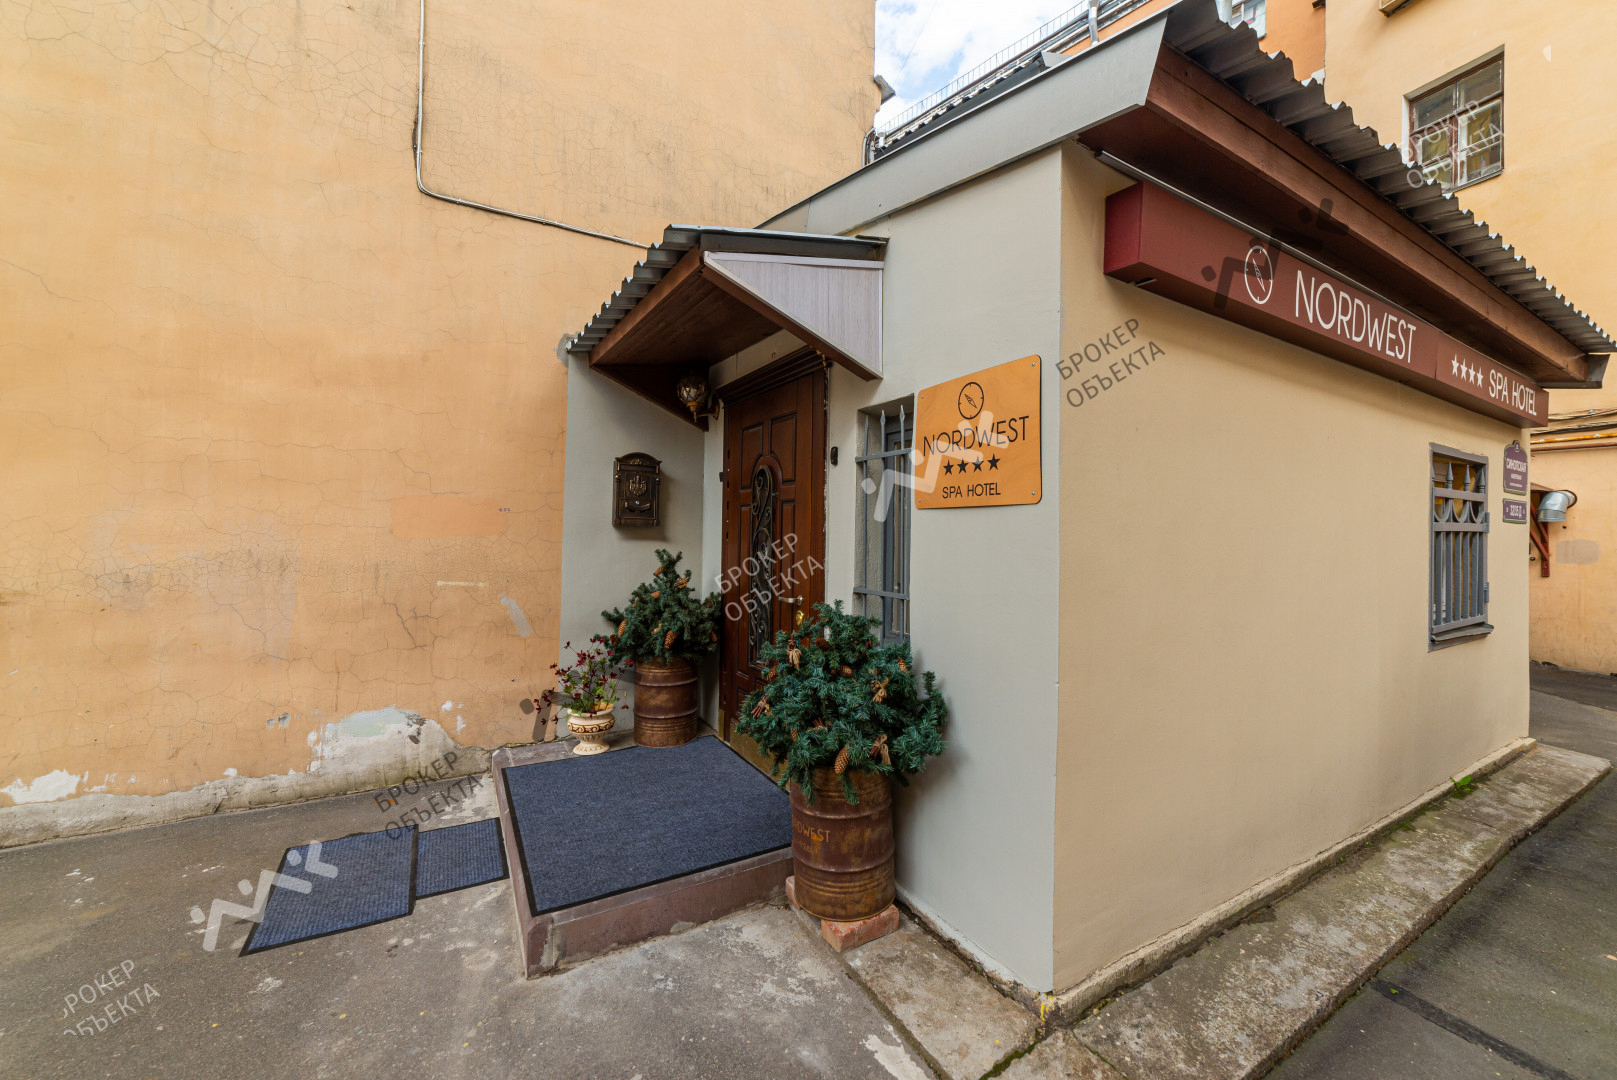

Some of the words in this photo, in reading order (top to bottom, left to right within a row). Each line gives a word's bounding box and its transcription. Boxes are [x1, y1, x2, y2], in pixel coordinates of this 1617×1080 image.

[1295, 270, 1416, 363] NORDWEST
[1488, 369, 1509, 405] SPA
[1512, 380, 1537, 417] HOTEL
[923, 415, 1030, 457] NORDWEST
[941, 485, 963, 499] SPA
[967, 482, 1001, 497] HOTEL
